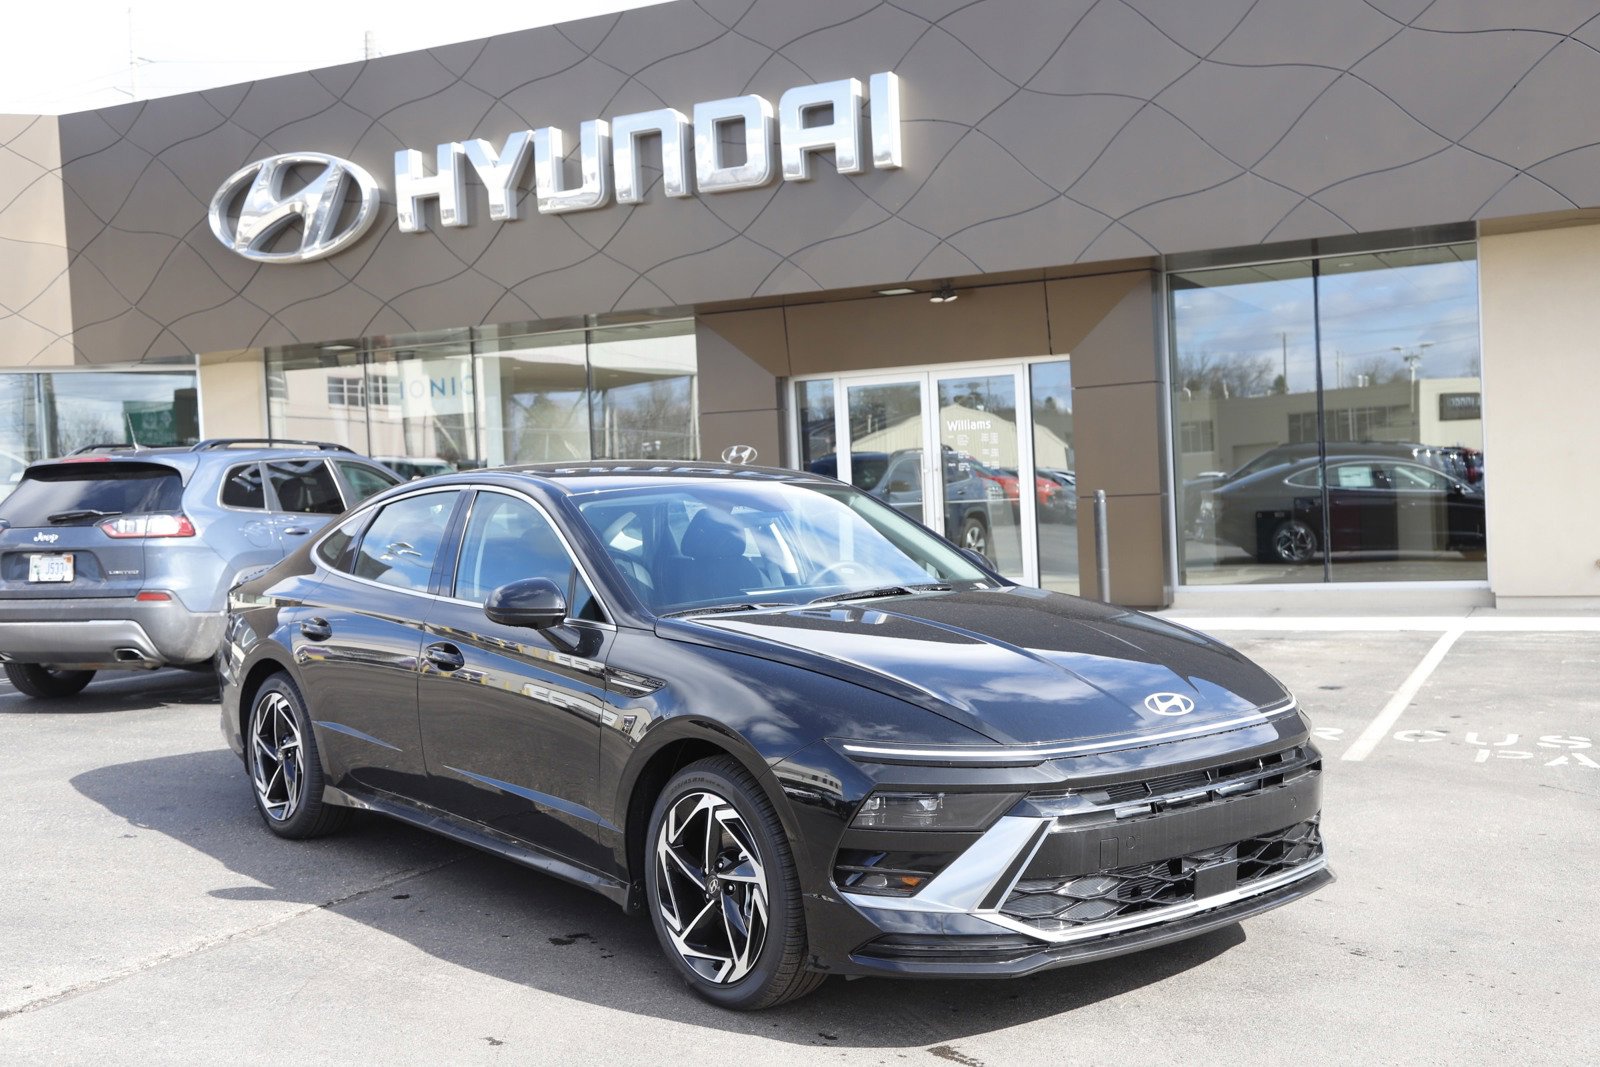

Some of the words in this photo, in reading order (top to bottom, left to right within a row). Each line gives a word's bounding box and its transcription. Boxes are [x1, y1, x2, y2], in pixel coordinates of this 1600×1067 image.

[394, 71, 902, 233] HYUNDAI
[947, 420, 991, 431] Williams
[33, 532, 59, 543] Jeep
